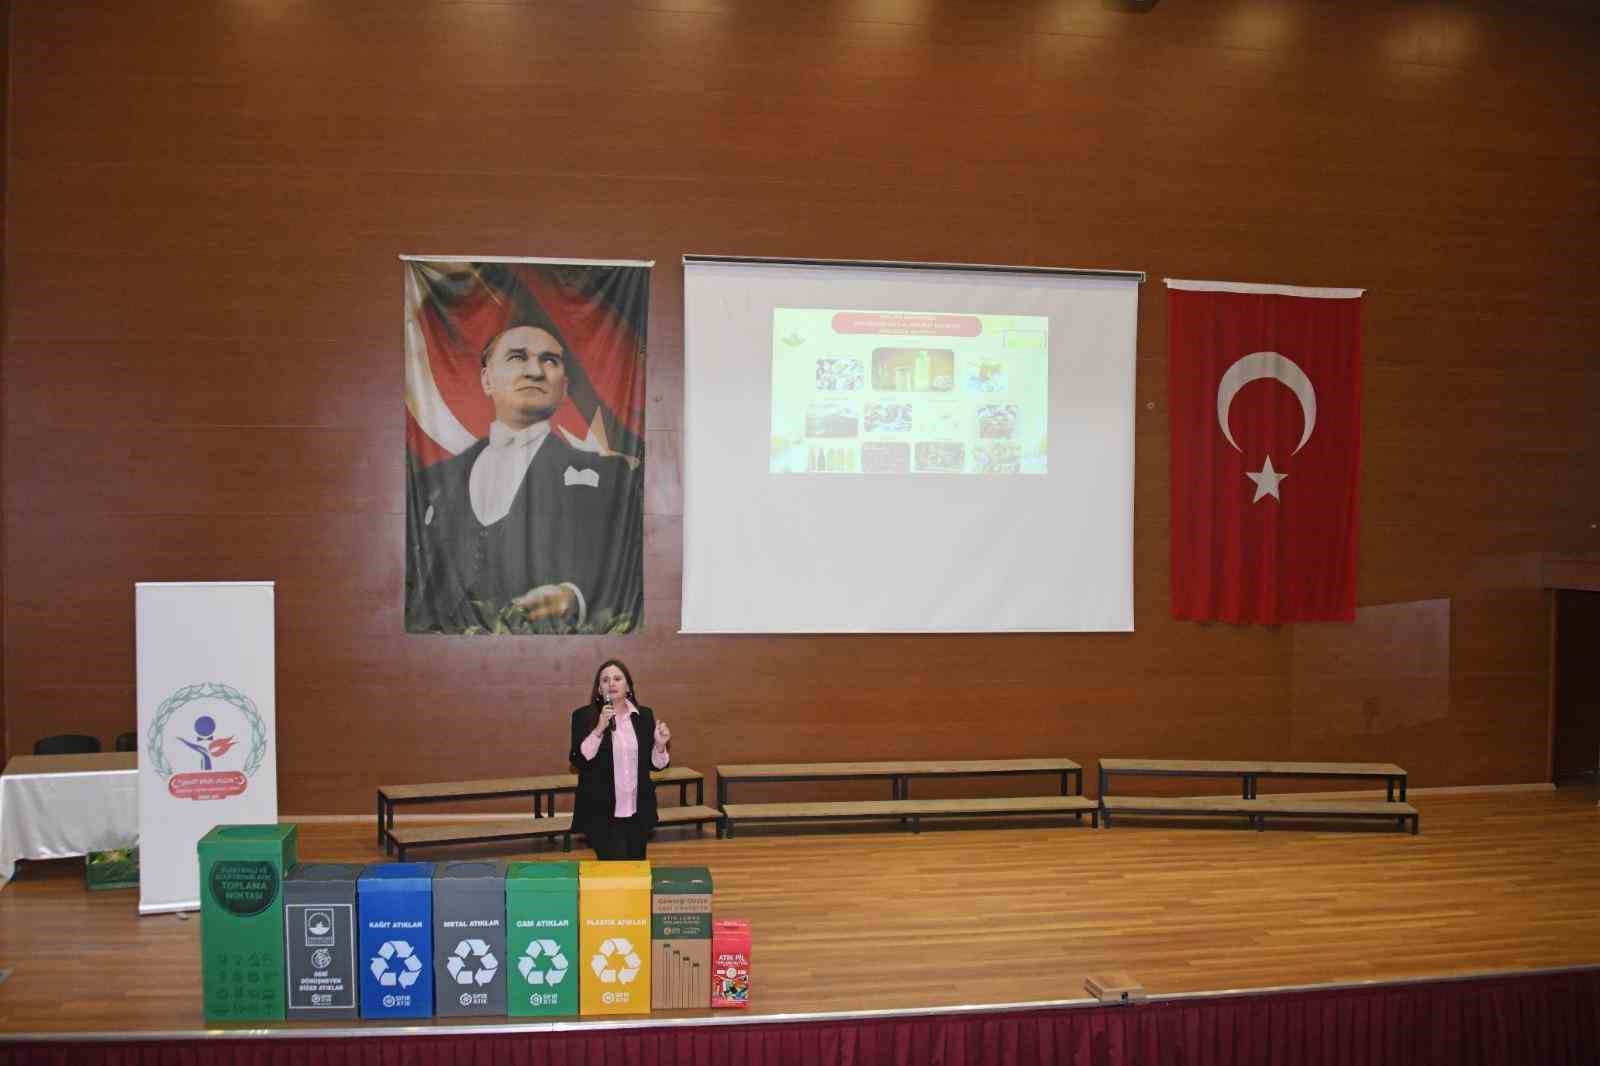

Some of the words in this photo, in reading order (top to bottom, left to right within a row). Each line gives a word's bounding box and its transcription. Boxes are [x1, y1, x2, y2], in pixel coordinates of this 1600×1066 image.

[221, 880, 267, 890] TOPLAMA
[392, 920, 423, 928] ATIKLAR
[443, 920, 468, 928] METAL
[469, 919, 500, 927] ATIKLAR
[536, 919, 569, 927] ATIKLAR
